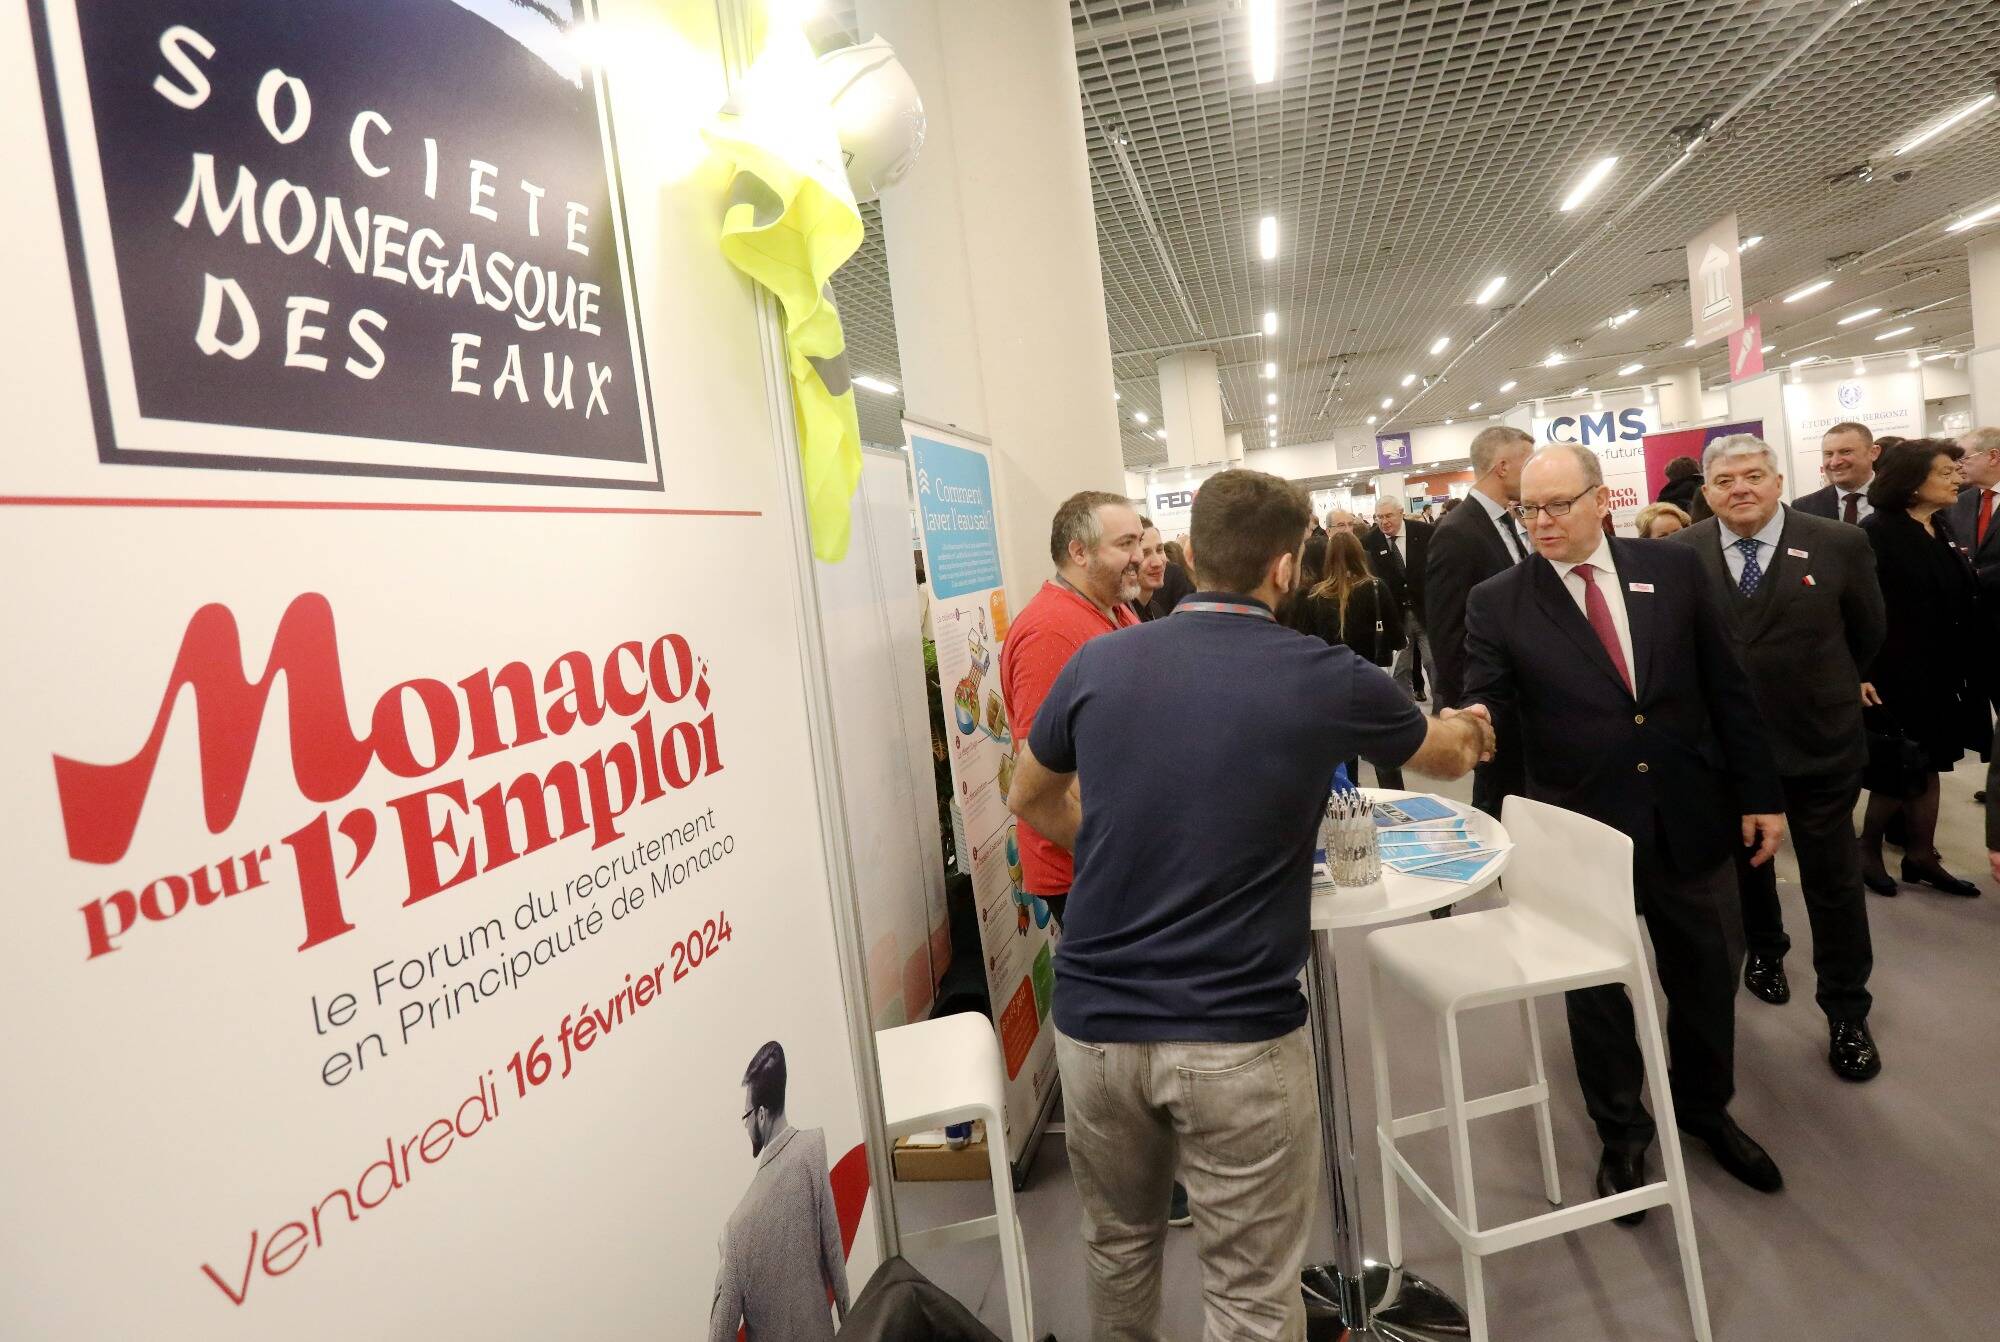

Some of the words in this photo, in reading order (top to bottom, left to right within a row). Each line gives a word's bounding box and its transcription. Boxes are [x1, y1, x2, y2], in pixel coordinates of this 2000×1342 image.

[153, 24, 591, 257] SOCIETE
[173, 152, 602, 337] MONEGASQUE
[195, 272, 388, 381] DES
[450, 332, 612, 419] EAUX
[1547, 408, 1646, 445] CMS
[52, 591, 694, 866] Monaco
[77, 843, 272, 962] pour
[281, 712, 724, 953] l'Emploi
[311, 995, 358, 1036] le
[372, 915, 505, 1006] Forum
[513, 885, 559, 933] du
[565, 807, 716, 909] recrutement
[321, 1033, 389, 1089] en
[399, 904, 605, 1046] Principauté
[611, 882, 645, 922] de
[651, 832, 736, 900] Monaco
[200, 1069, 501, 1308] Vendredi
[506, 1036, 555, 1099] 16
[557, 962, 665, 1079] février
[670, 911, 732, 984] 2024
